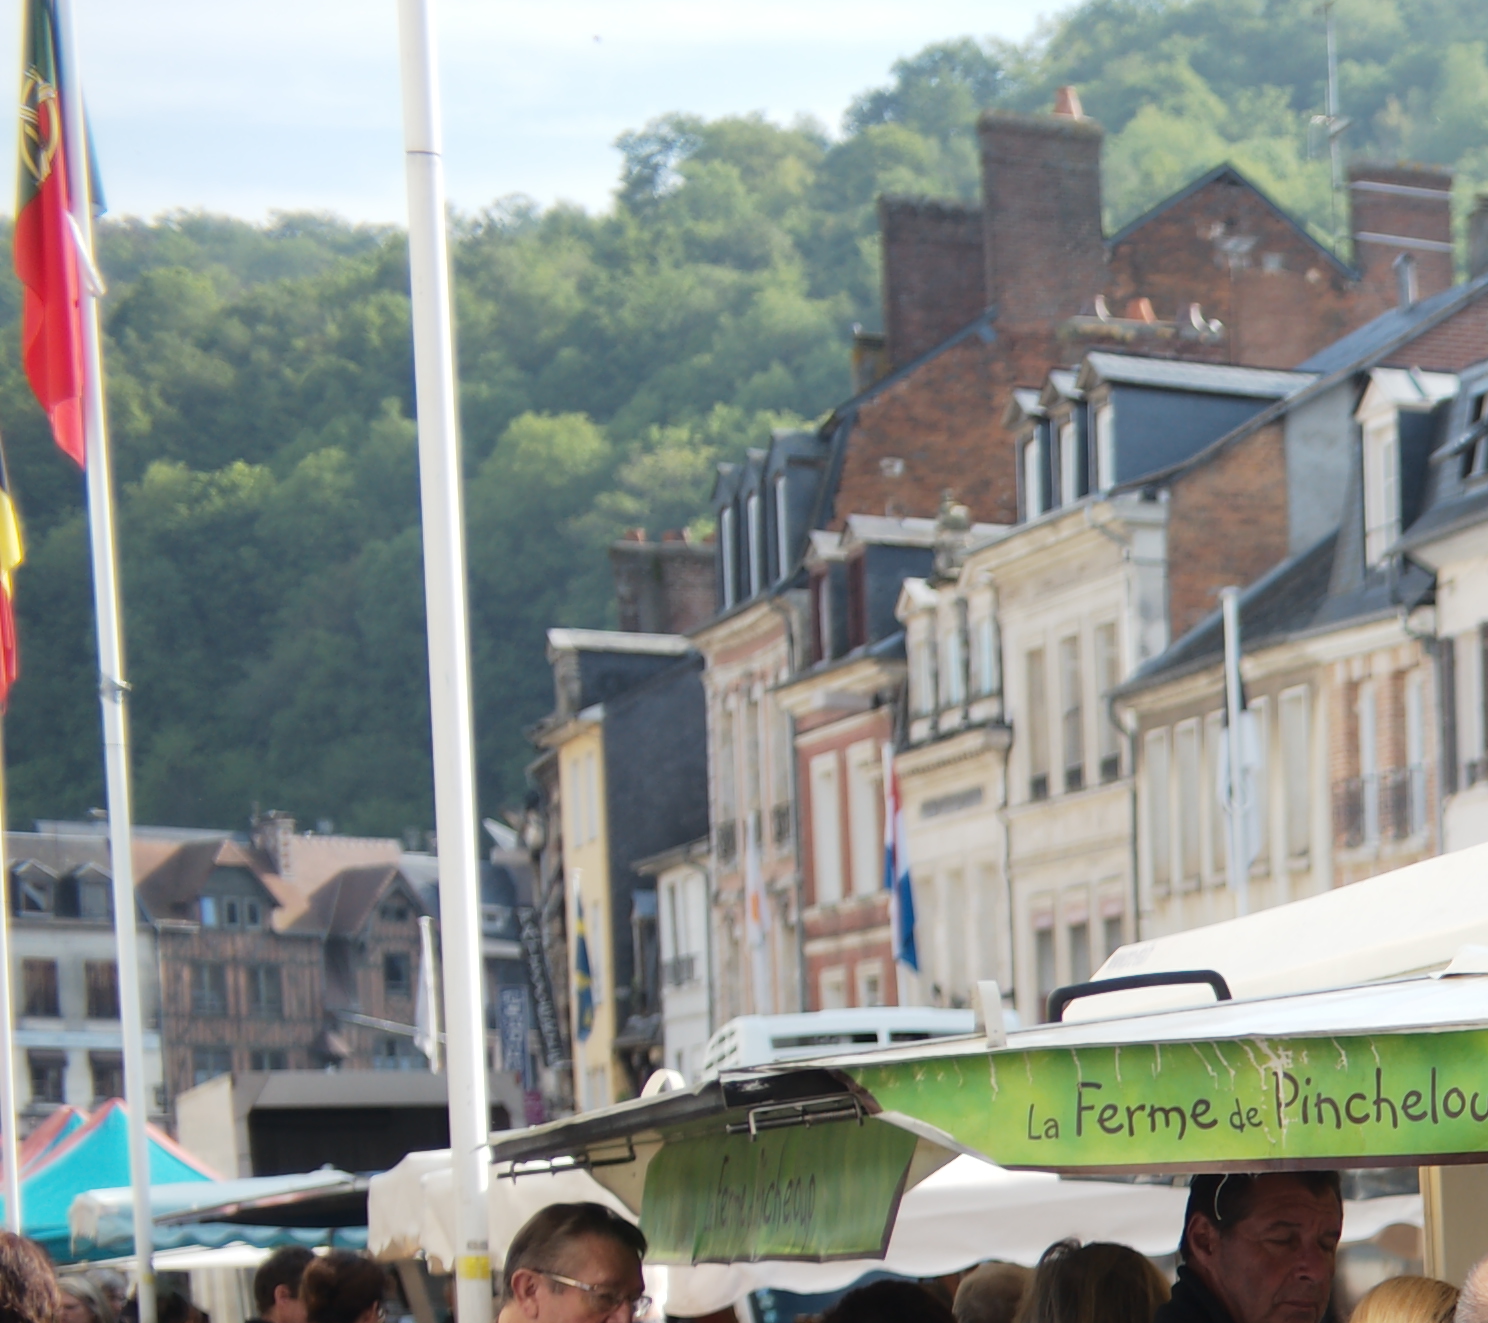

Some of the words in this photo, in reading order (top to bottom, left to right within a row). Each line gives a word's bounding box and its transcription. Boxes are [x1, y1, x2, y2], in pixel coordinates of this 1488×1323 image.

[1027, 1103, 1060, 1141] La
[1075, 1082, 1218, 1141] Ferme
[1228, 1097, 1263, 1134] de
